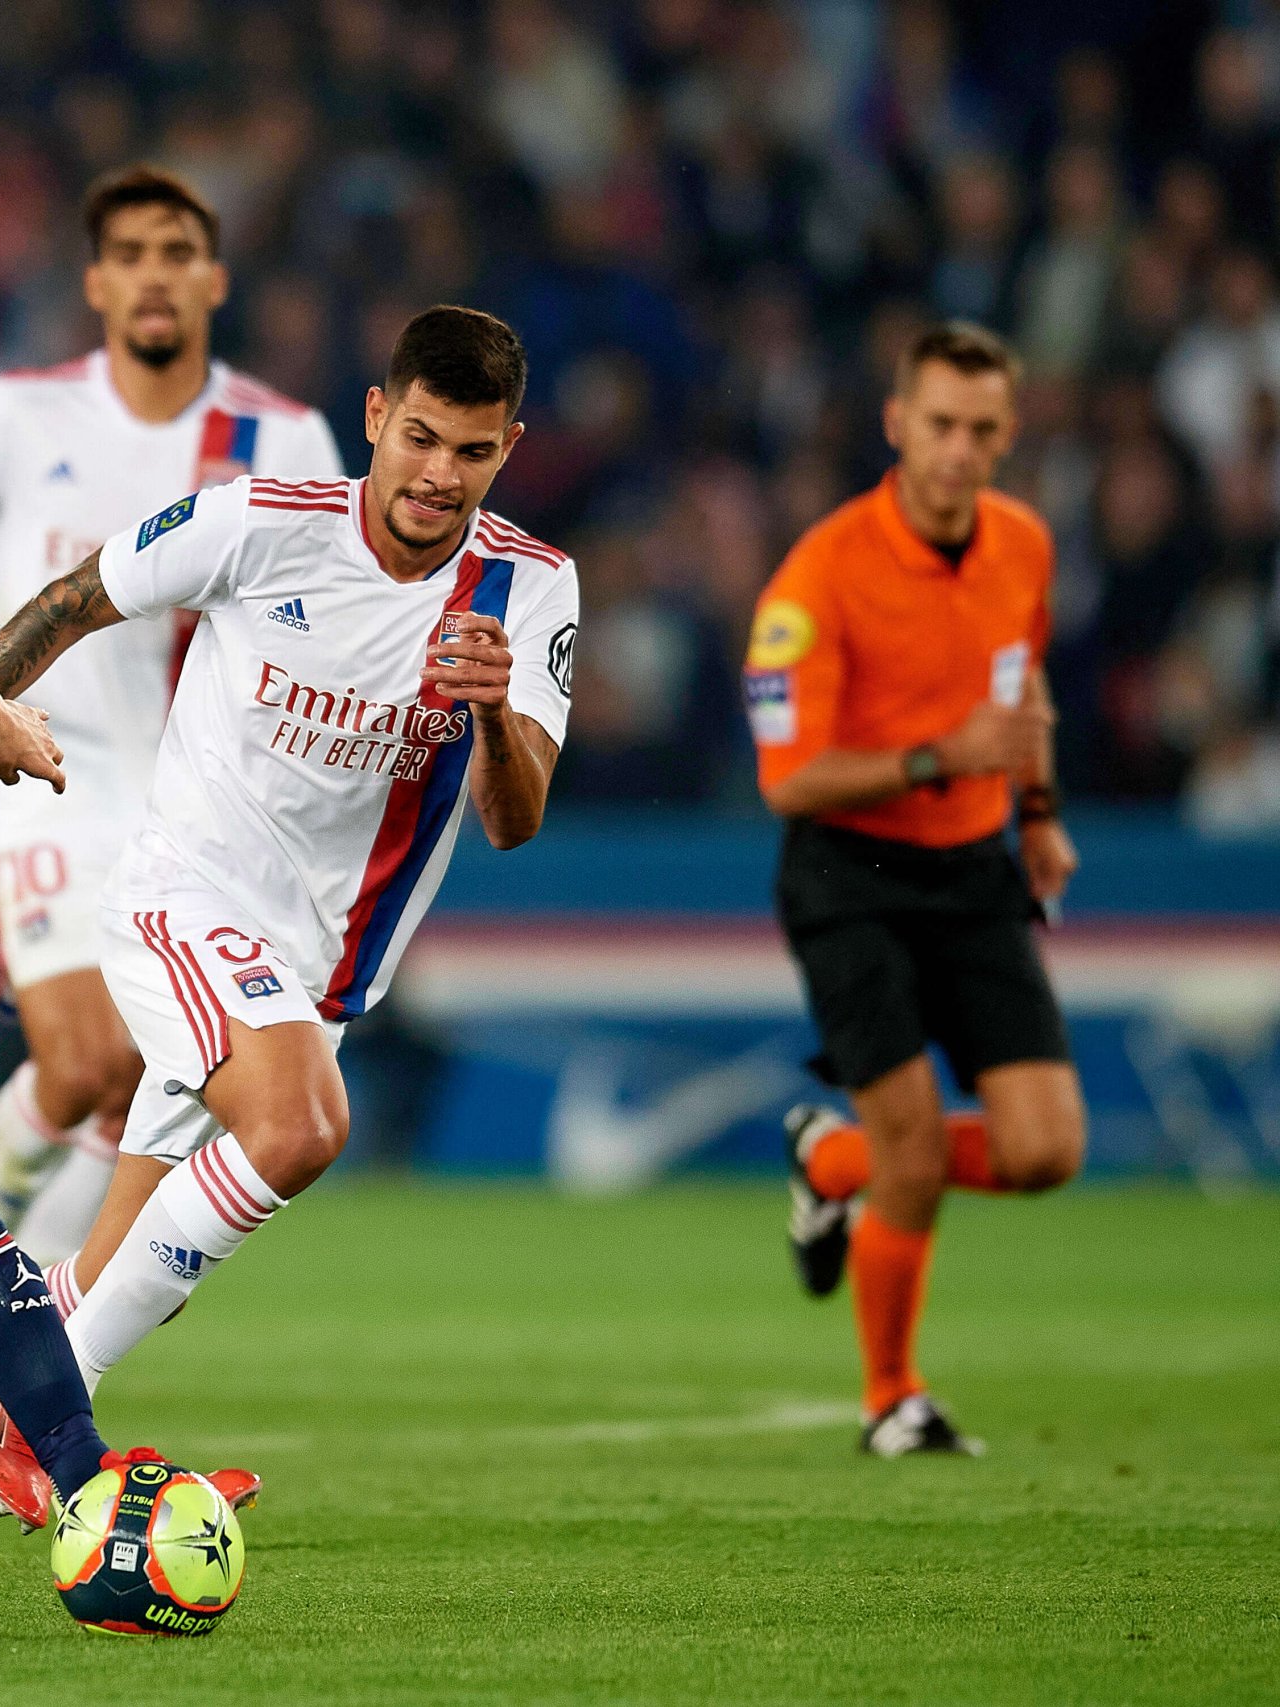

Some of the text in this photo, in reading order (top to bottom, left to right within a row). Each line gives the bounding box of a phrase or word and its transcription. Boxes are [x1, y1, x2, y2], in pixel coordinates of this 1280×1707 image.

[267, 610, 310, 632] adidas
[254, 659, 468, 743] Emirates
[270, 720, 428, 781] FLY BETTER
[149, 1240, 202, 1281] adidas
[120, 1493, 155, 1507] ELYSIA
[116, 1545, 134, 1554] FIFA
[145, 1604, 224, 1635] uhlspo
